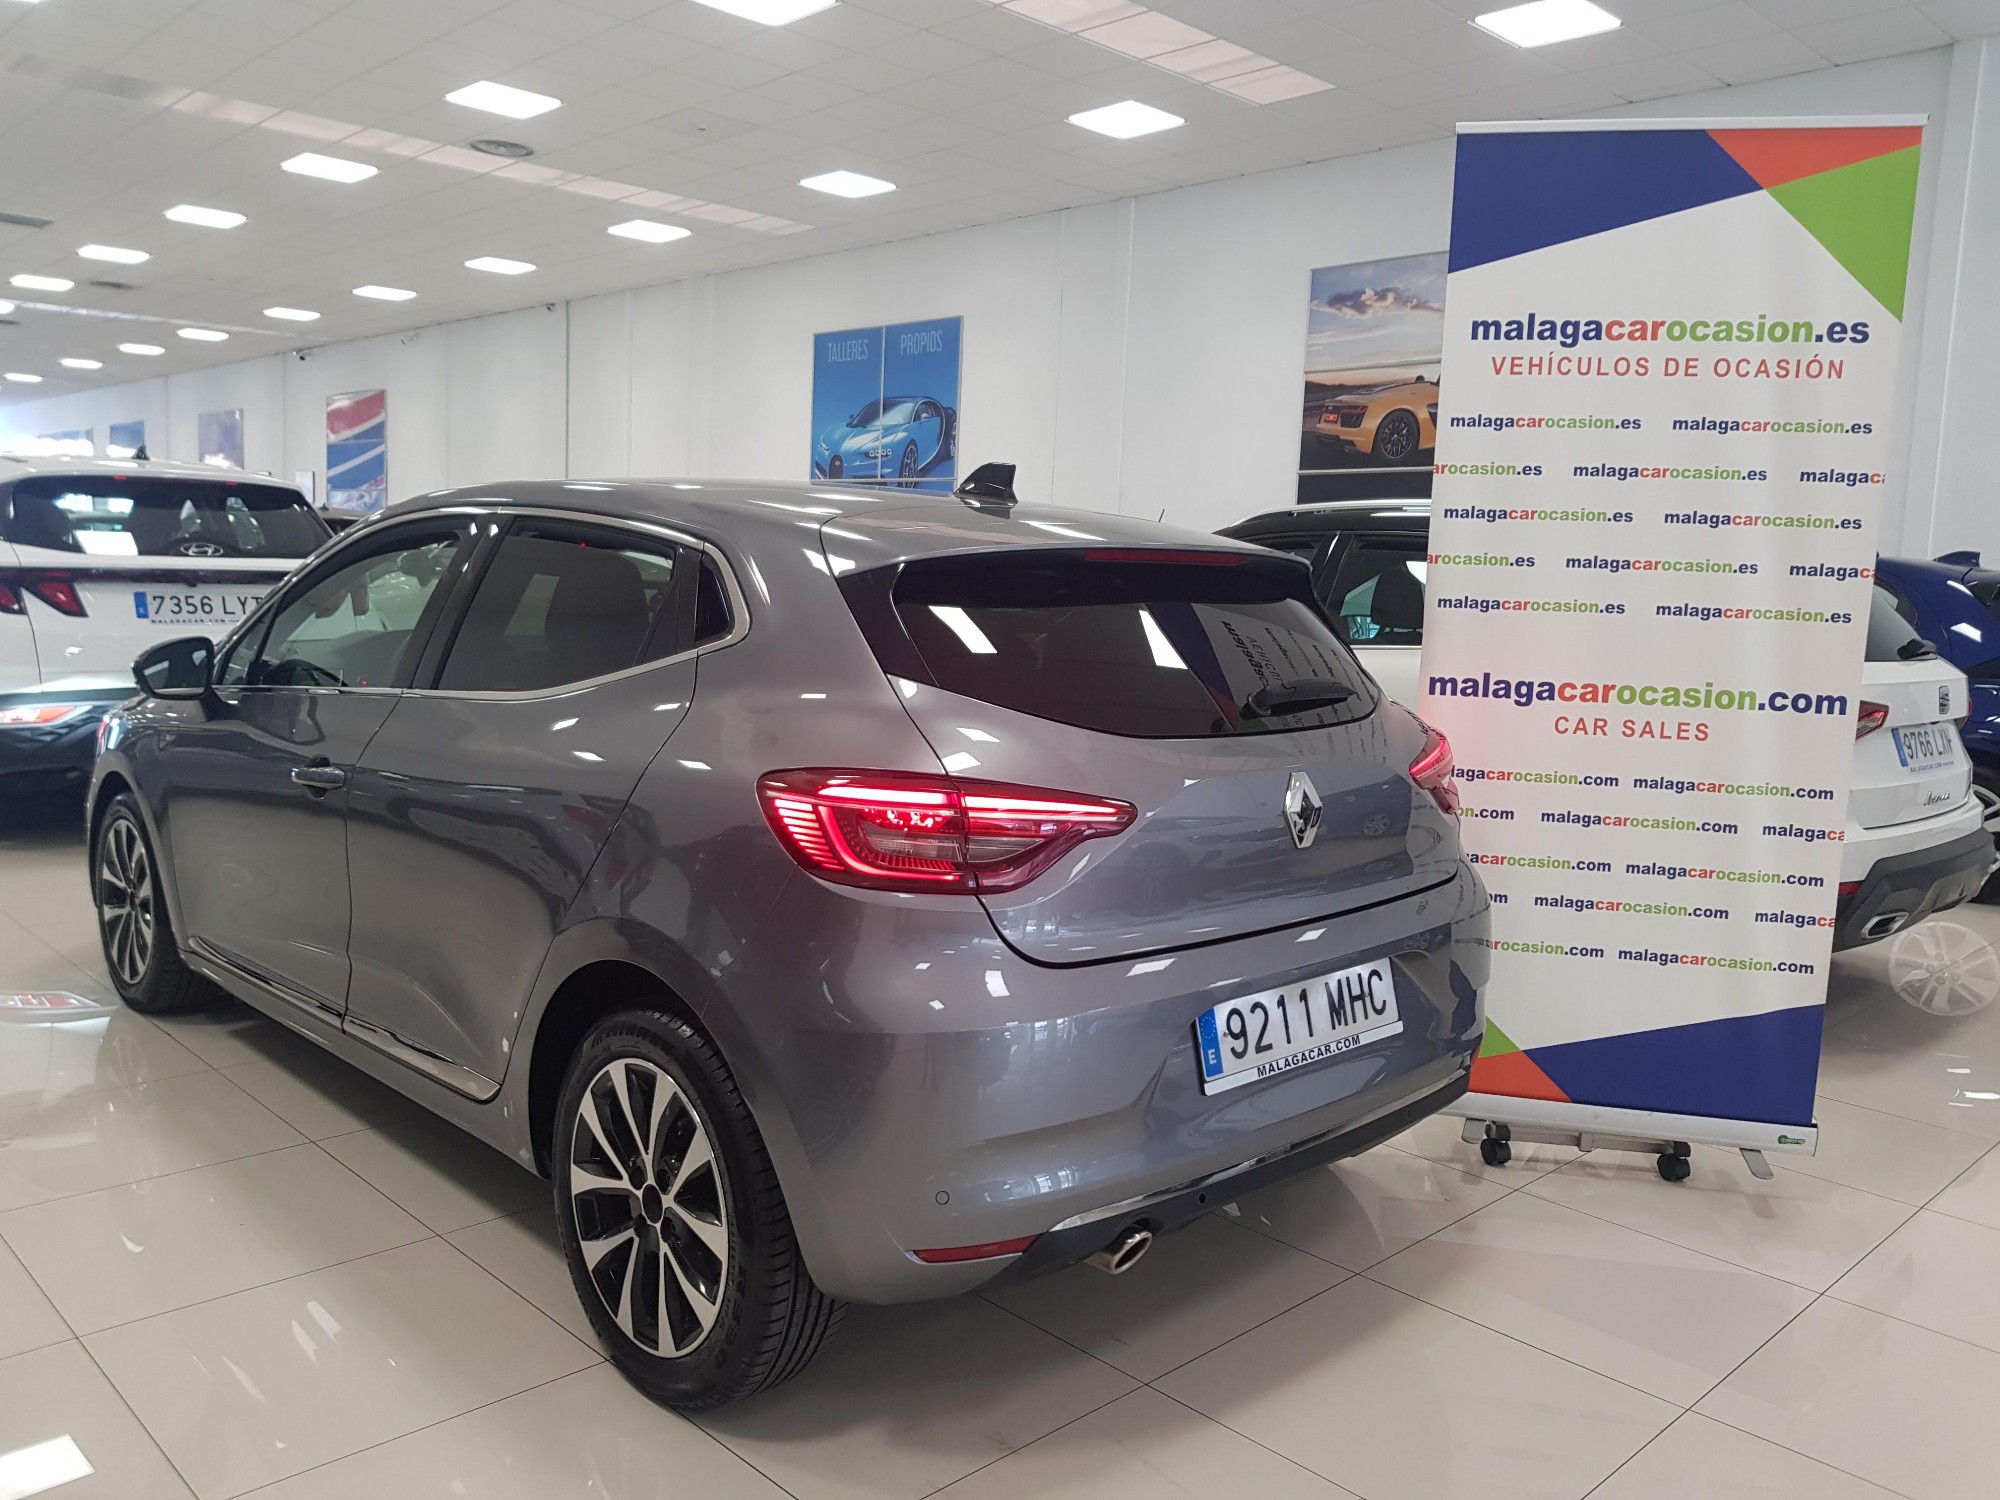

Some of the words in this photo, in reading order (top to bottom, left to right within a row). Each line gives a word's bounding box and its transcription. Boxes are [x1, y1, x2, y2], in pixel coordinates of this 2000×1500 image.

[1470, 312, 1870, 349] malagacarocasion.es
[828, 338, 869, 362] TALLERES
[900, 330, 943, 356] PROPIOS
[1491, 352, 1649, 377] VEHÍCULOS
[1663, 357, 1699, 377] DE
[1713, 353, 1844, 379] OCASIÓN
[1450, 413, 1642, 432] malagacarocasion.es
[1672, 416, 1873, 435] malagacarocasion.es
[1573, 463, 1768, 482] malagacarocasion.es
[1443, 505, 1634, 523] malagacarocasion.es
[1664, 510, 1862, 530] malagacarocasion.es
[1565, 555, 1759, 575] malagacarocasion.es
[152, 595, 214, 615] 7356
[1437, 595, 1626, 615] malagacarocasion.es
[1655, 602, 1852, 624] malagacarocasion.es
[1428, 671, 1848, 716] malagacarocasion.com
[1554, 715, 1608, 737] CAR
[1621, 719, 1710, 742] SALES
[1903, 730, 1934, 760] 9766
[1633, 776, 1834, 801] malagacarocasion.com
[1540, 810, 1739, 835] malagacarocasion.com
[1467, 852, 1612, 874] acarocasion.com
[1625, 862, 1825, 888] malagacarocasion.com
[1534, 894, 1730, 920] malagacarocasion.com
[1618, 948, 1815, 975] malagacarocasion.com
[1207, 1049, 1217, 1065] E
[1226, 987, 1314, 1060] 9211
[1325, 968, 1387, 1031] MHC
[1256, 1034, 1361, 1078] MALAGACAR.COM
